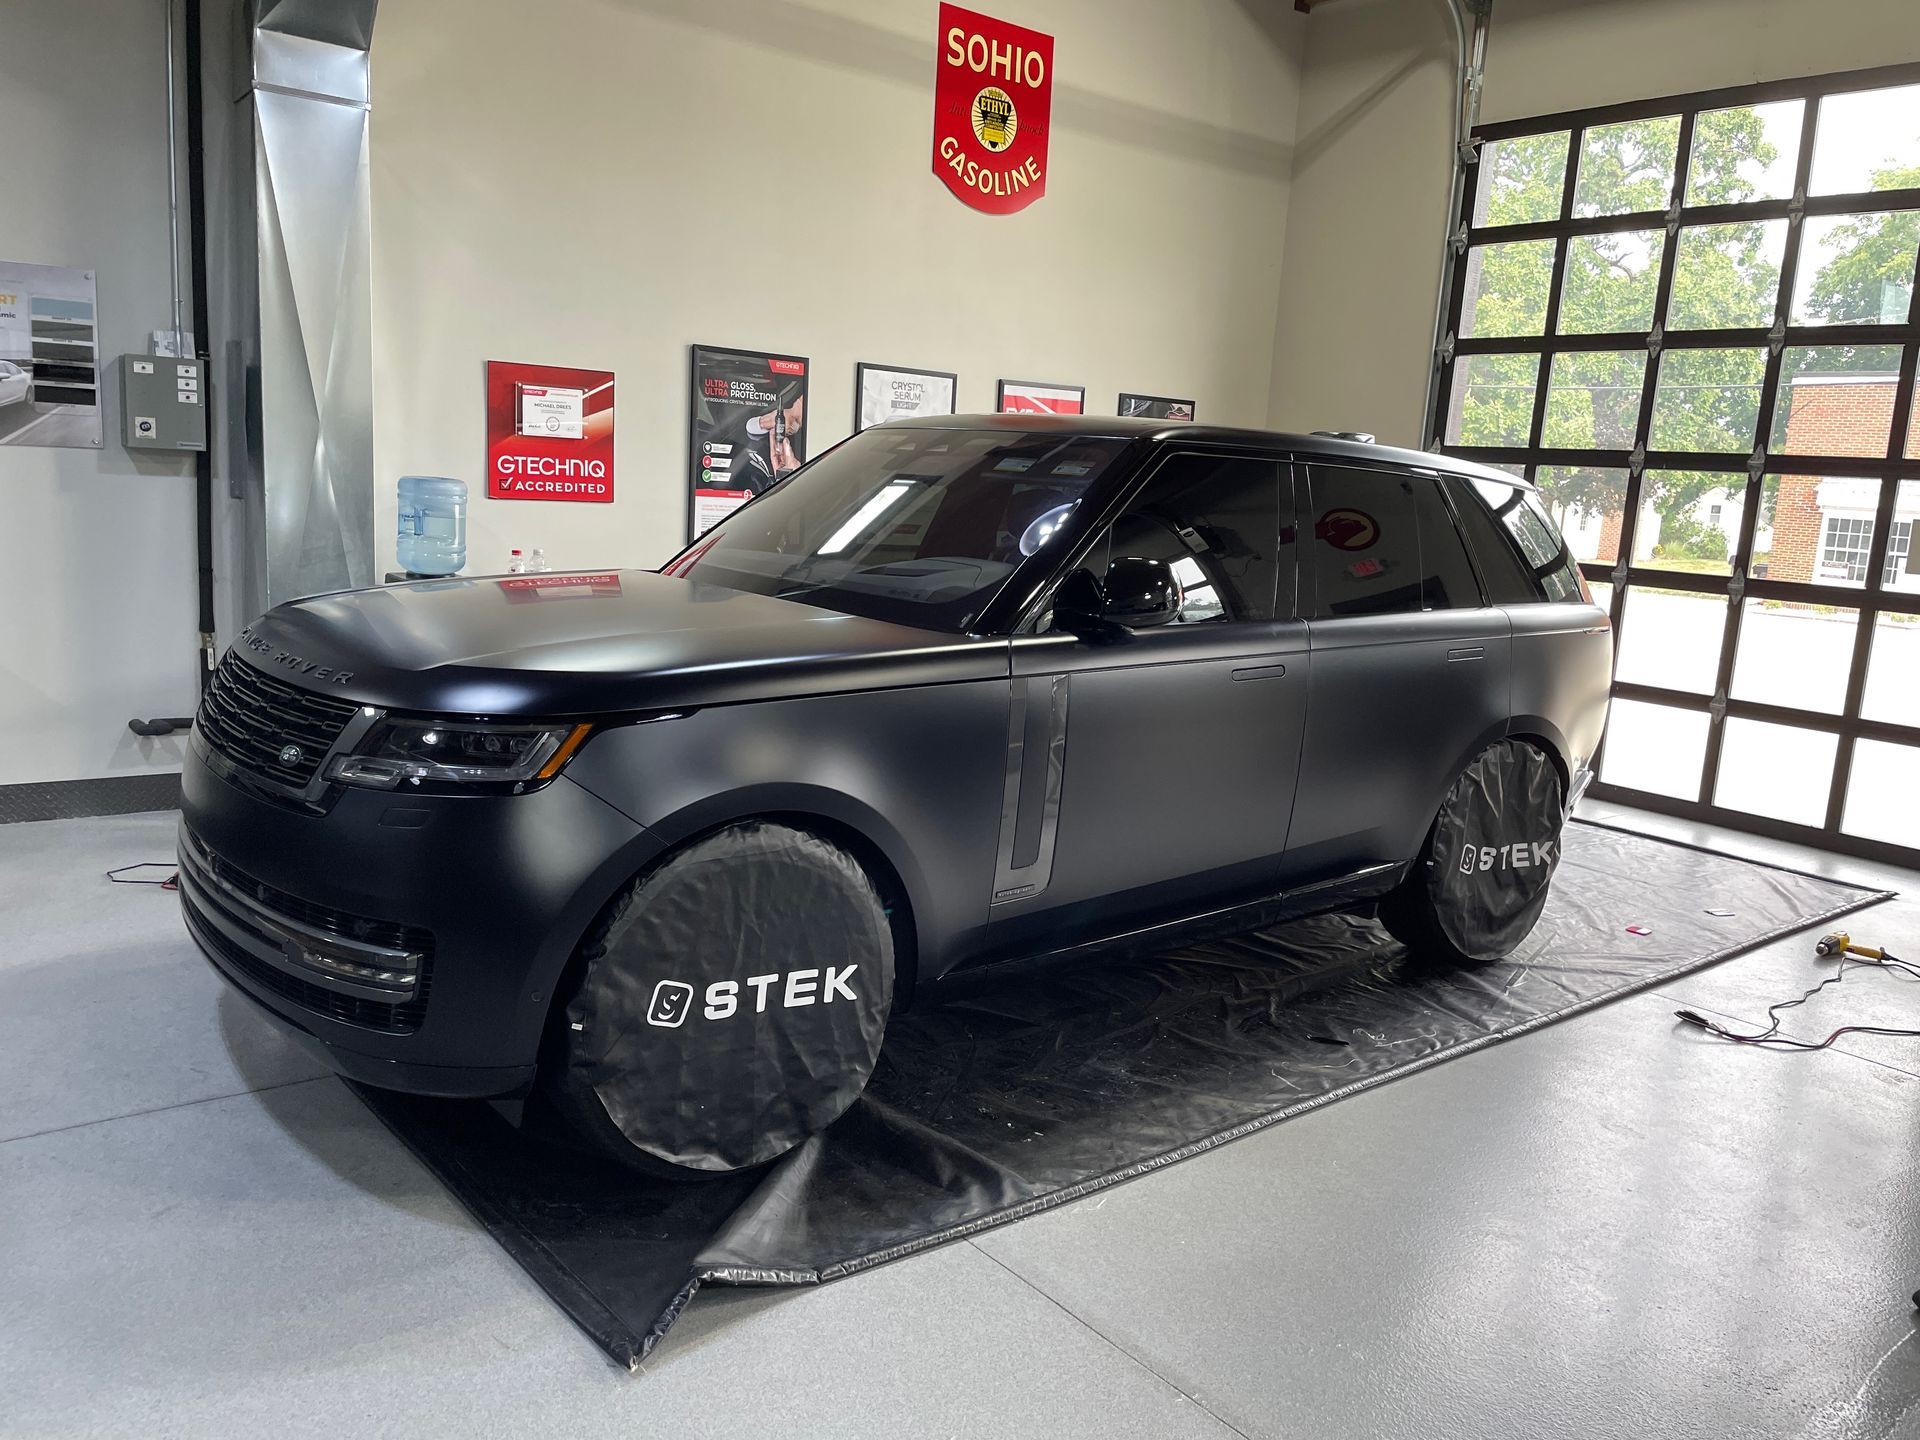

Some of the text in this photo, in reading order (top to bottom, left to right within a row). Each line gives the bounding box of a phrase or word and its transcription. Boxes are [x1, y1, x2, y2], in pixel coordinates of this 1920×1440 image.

[947, 27, 1045, 88] SOHIO
[981, 97, 1010, 116] ETHYL
[940, 136, 1041, 196] GASOLINE
[0, 311, 16, 319] mic
[704, 378, 756, 392] ULTRA GLOSS,
[704, 387, 777, 402] ULTRA PROTECTION
[894, 390, 921, 402] SERUM
[497, 455, 606, 478] GTECHNIQ
[515, 480, 606, 494] ACCREDITED
[274, 651, 354, 685] ROVER
[1479, 841, 1553, 871] STEK
[703, 964, 859, 1021] STEK
